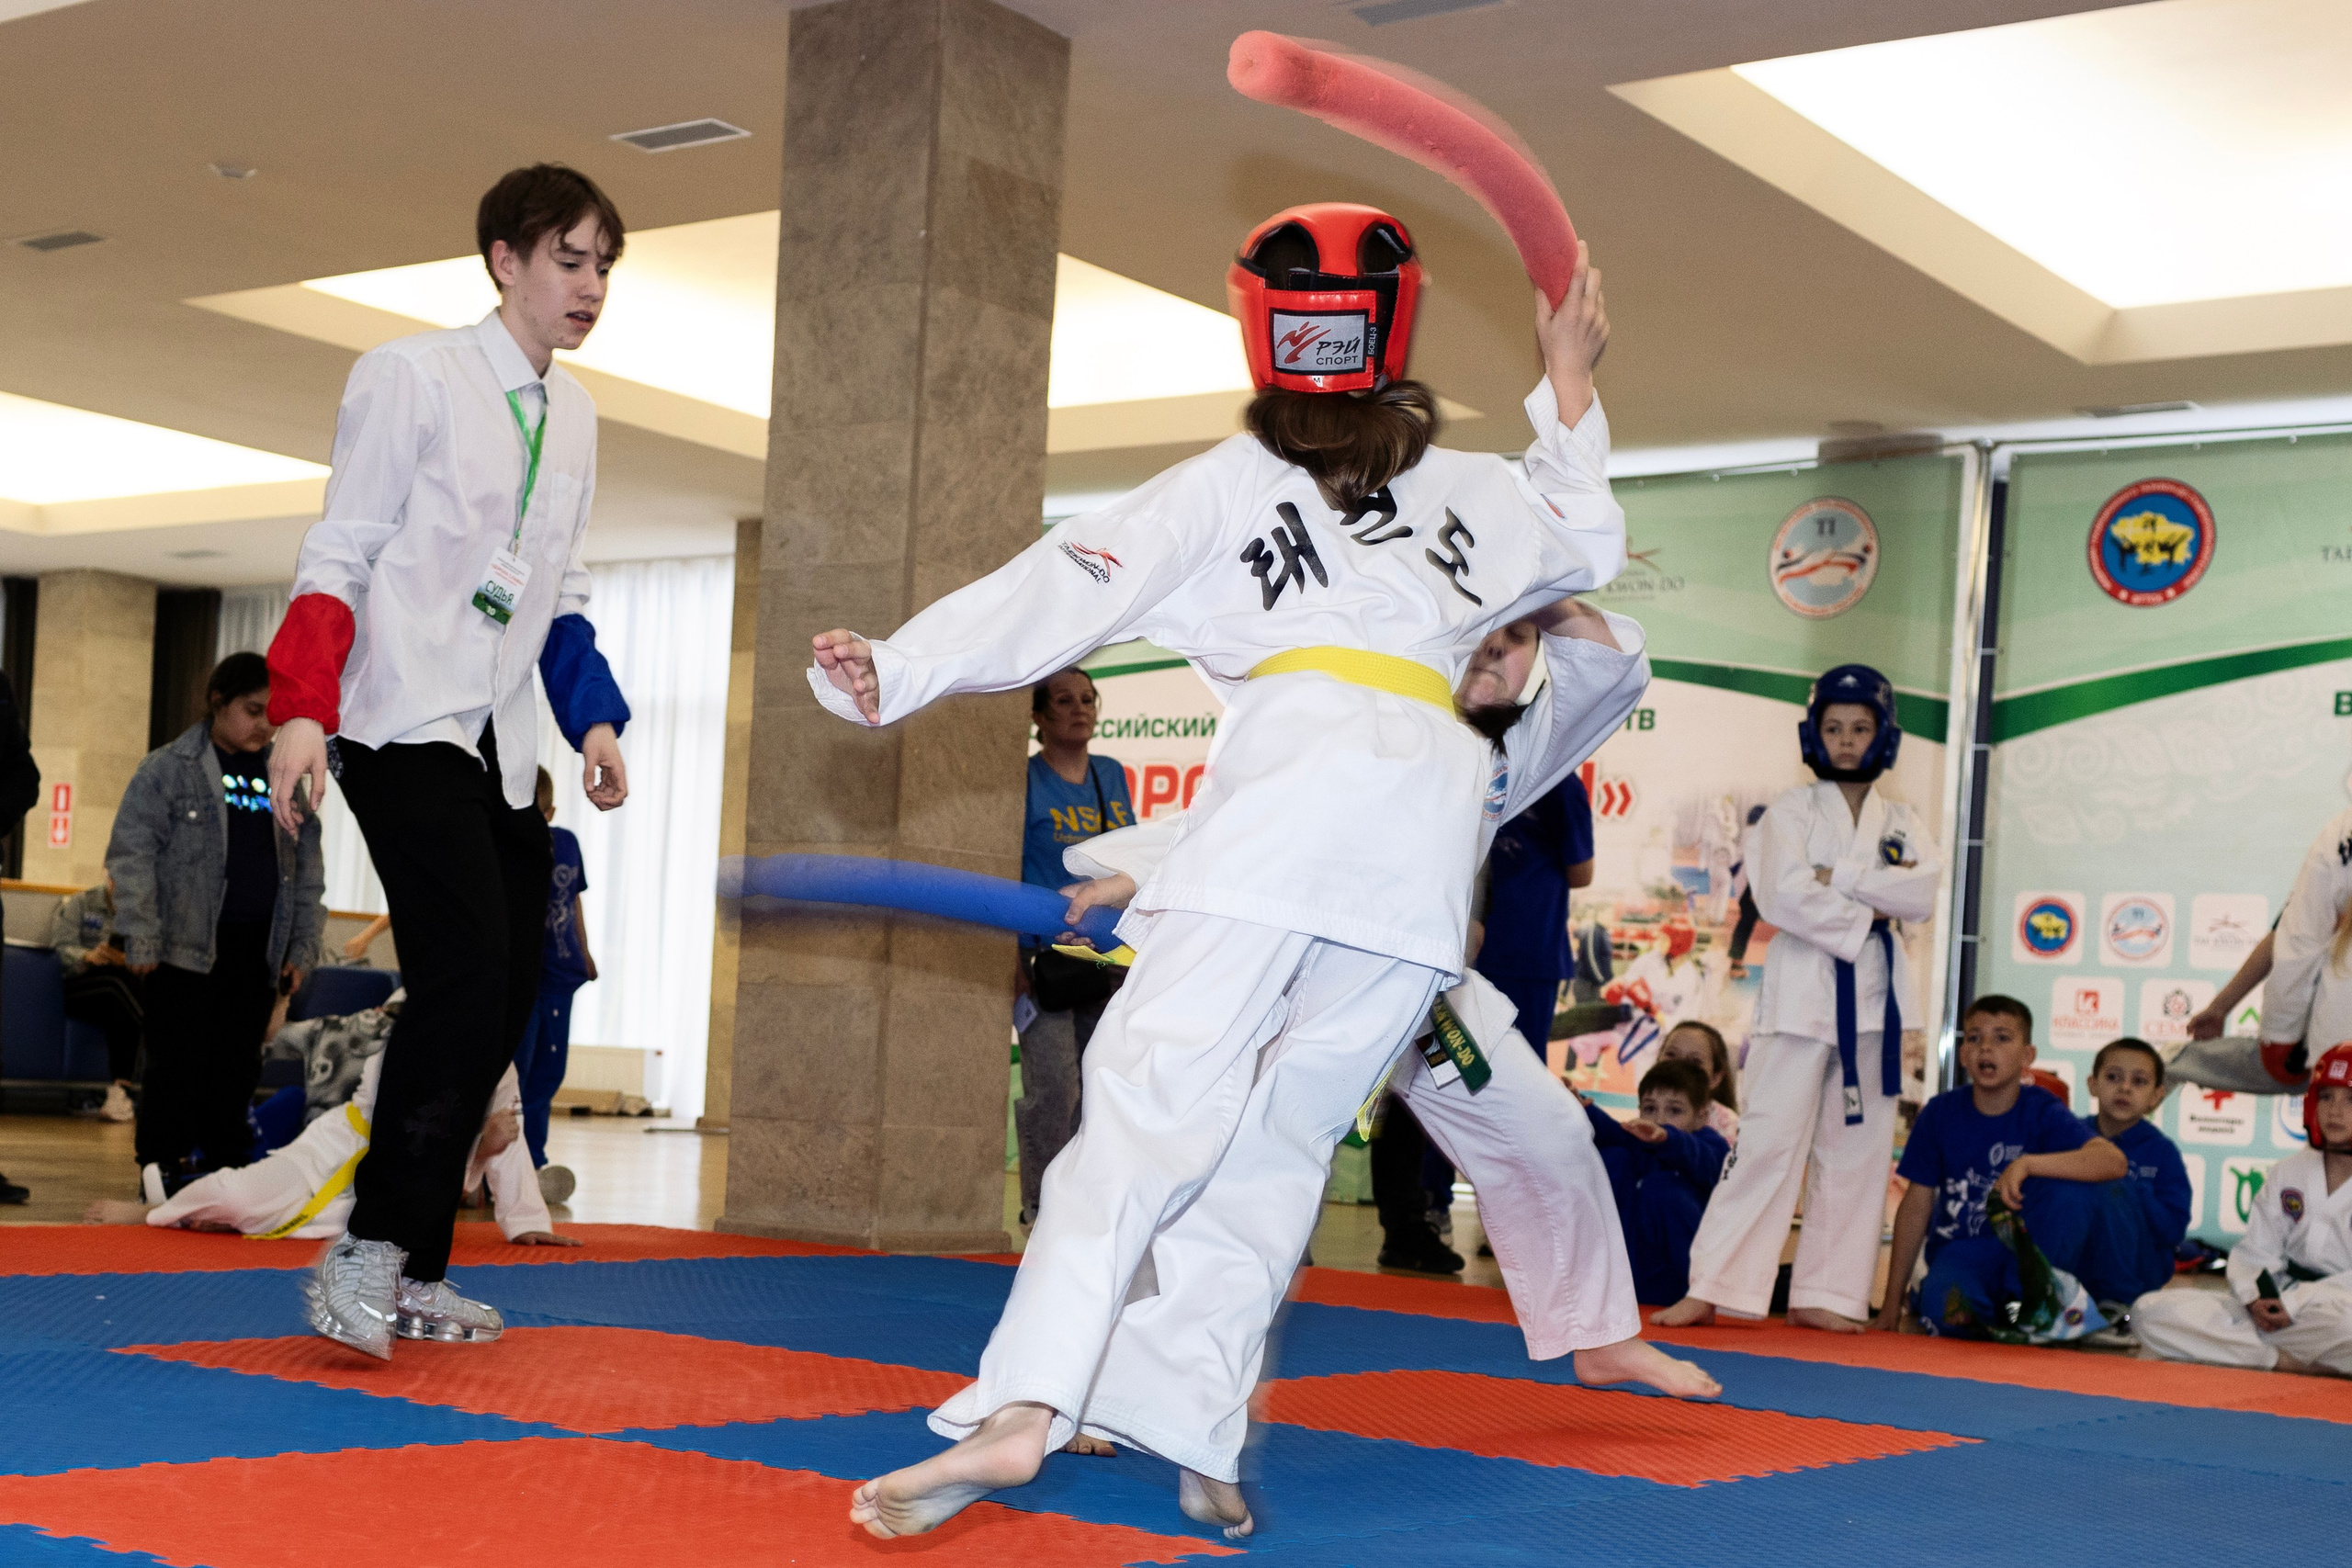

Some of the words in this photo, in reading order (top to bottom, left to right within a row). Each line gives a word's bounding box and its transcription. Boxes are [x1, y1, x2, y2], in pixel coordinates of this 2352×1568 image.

[1317, 336, 1361, 356] РЭЙ
[1367, 326, 1377, 355] БОЕЦ-3
[1317, 355, 1358, 366] СПОРТ
[485, 580, 514, 605] СУДЬЯ
